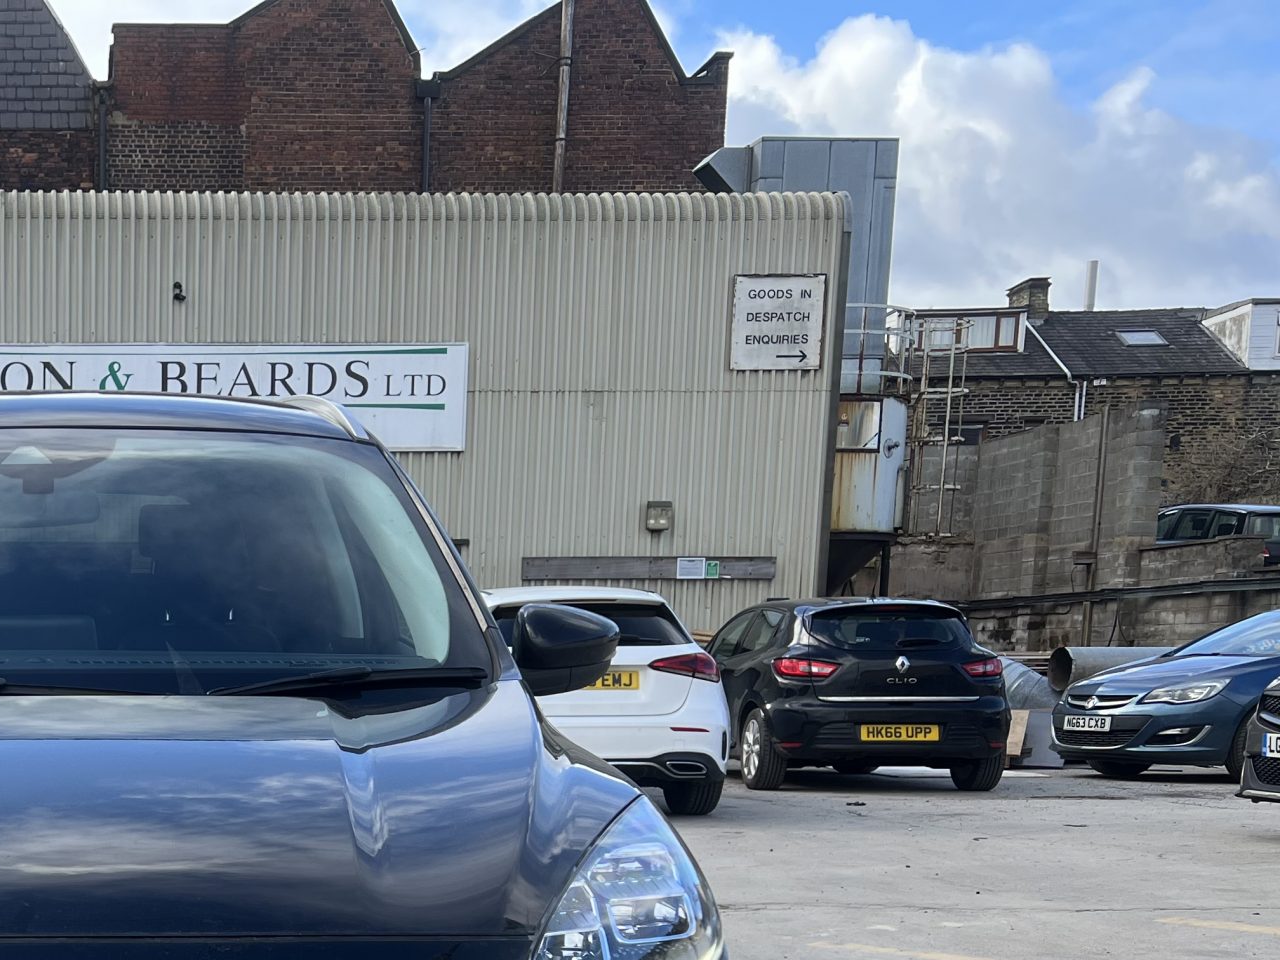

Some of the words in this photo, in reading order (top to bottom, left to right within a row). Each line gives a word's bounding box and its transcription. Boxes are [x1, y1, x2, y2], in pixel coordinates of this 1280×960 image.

[748, 289, 793, 300] GOODS
[800, 288, 812, 299] IN
[746, 311, 811, 322] DESPATCH
[745, 333, 809, 345] ENQUIRIES
[99, 361, 135, 391] &
[157, 359, 370, 398] BEARDS
[384, 374, 447, 397] LTD
[601, 672, 633, 687] EMJ
[1087, 717, 1106, 729] CXB
[866, 726, 902, 739] HK66
[905, 726, 932, 739] UPP
